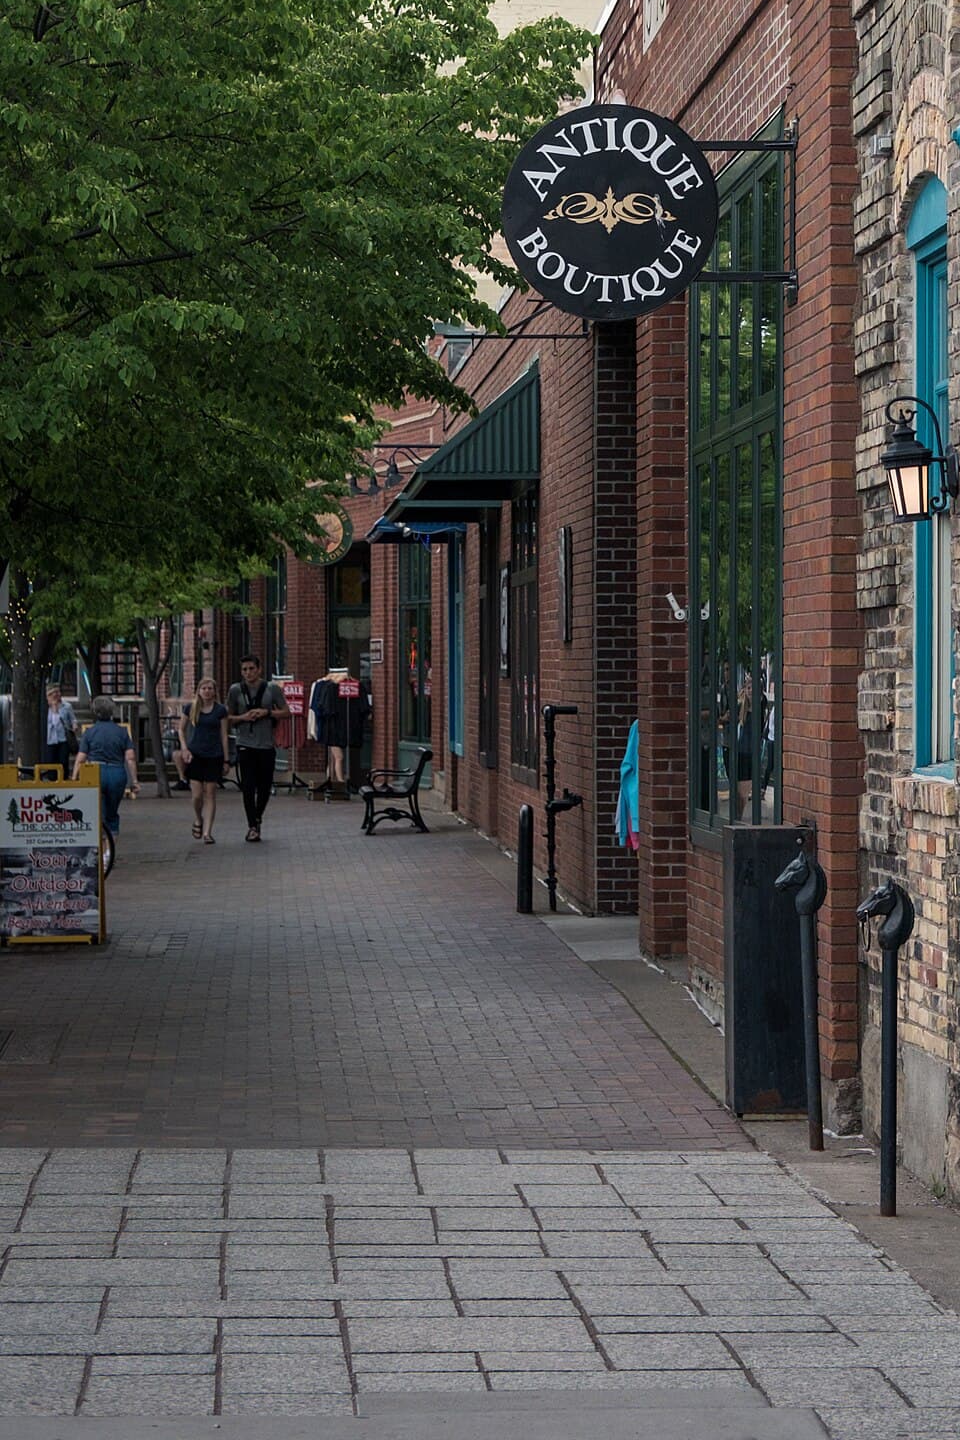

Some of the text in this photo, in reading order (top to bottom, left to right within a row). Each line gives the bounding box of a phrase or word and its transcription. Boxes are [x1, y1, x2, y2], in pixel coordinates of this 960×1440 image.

[522, 117, 703, 202] ANTIQUE
[517, 227, 702, 303] BOUTIQUE
[284, 685, 304, 696] SALE
[20, 797, 43, 812] Up
[20, 810, 73, 823] North
[22, 822, 92, 832] THE GOOD LIFE
[28, 851, 69, 868] Your
[12, 873, 86, 892] Outdoor
